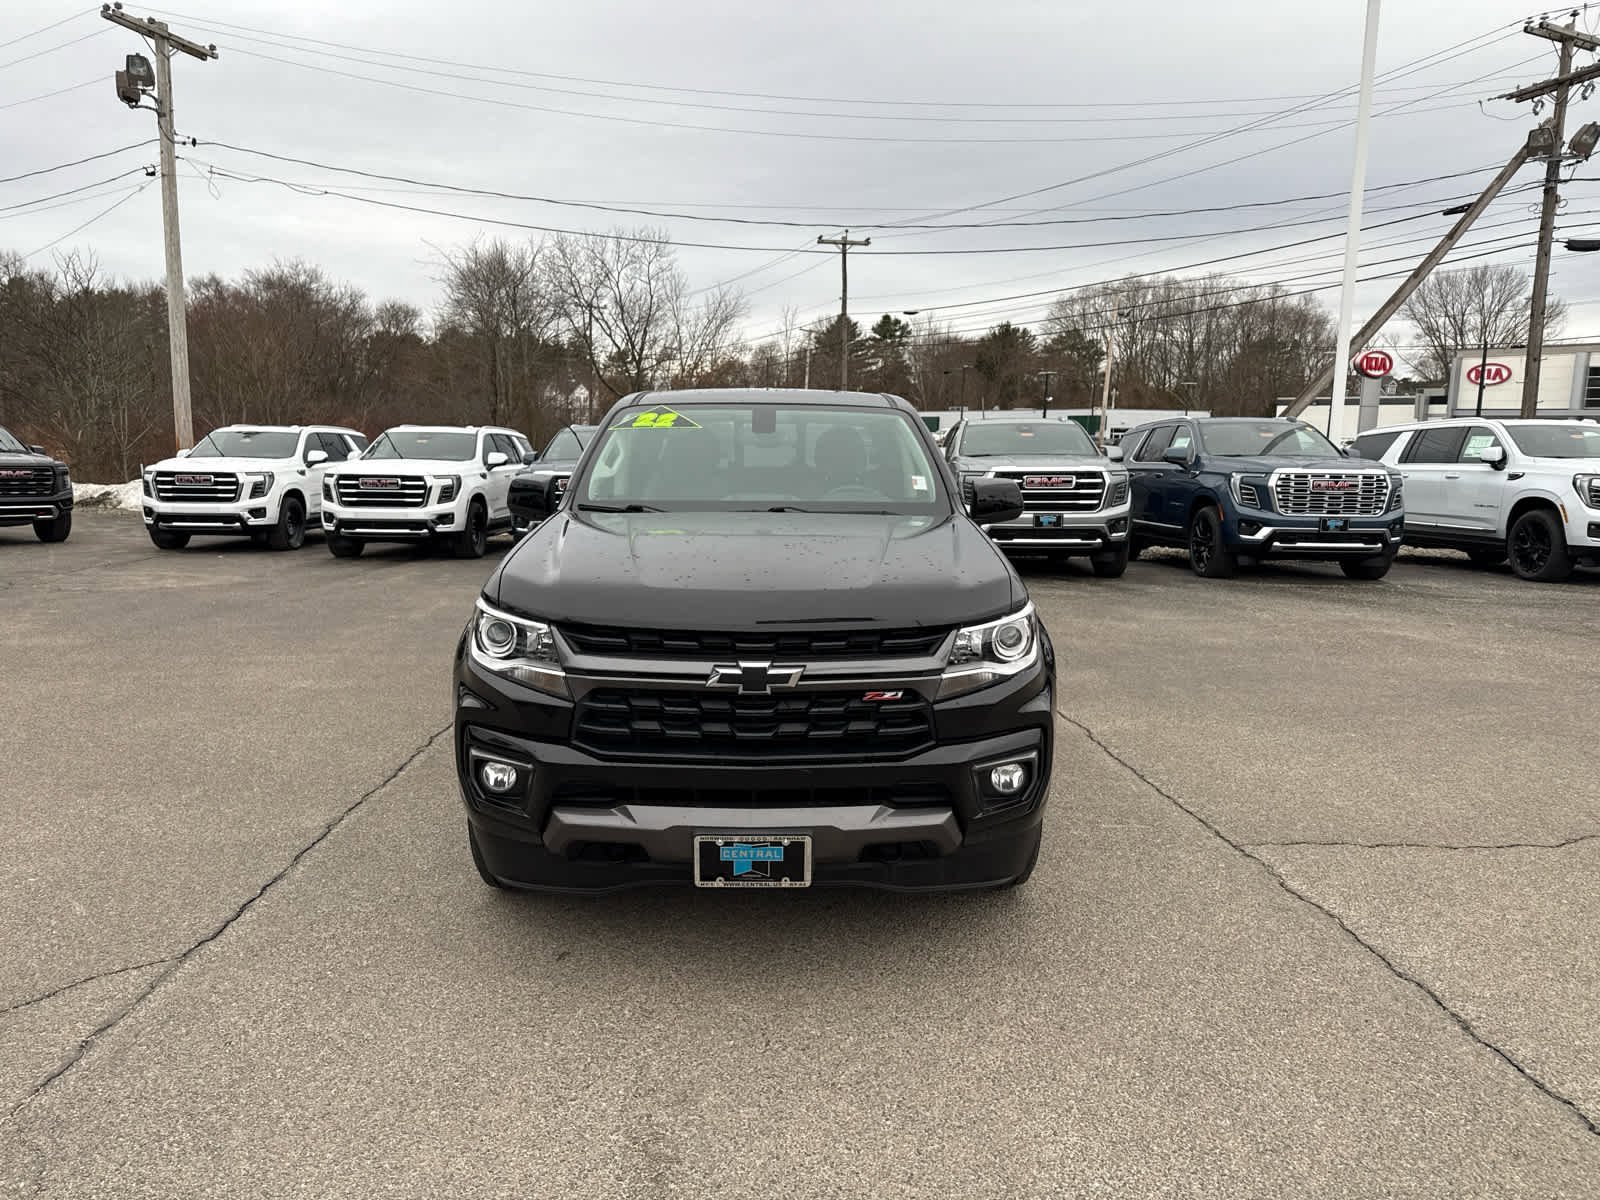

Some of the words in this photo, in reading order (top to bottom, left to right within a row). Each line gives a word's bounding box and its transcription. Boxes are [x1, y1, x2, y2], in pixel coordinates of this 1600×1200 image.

[1366, 356, 1387, 370] KIA
[631, 412, 678, 427] 22
[176, 476, 211, 484] GMC
[361, 479, 399, 487] GMC
[1026, 476, 1072, 487] GMC
[1312, 479, 1359, 490] GMC
[723, 850, 780, 858] CENTRAL
